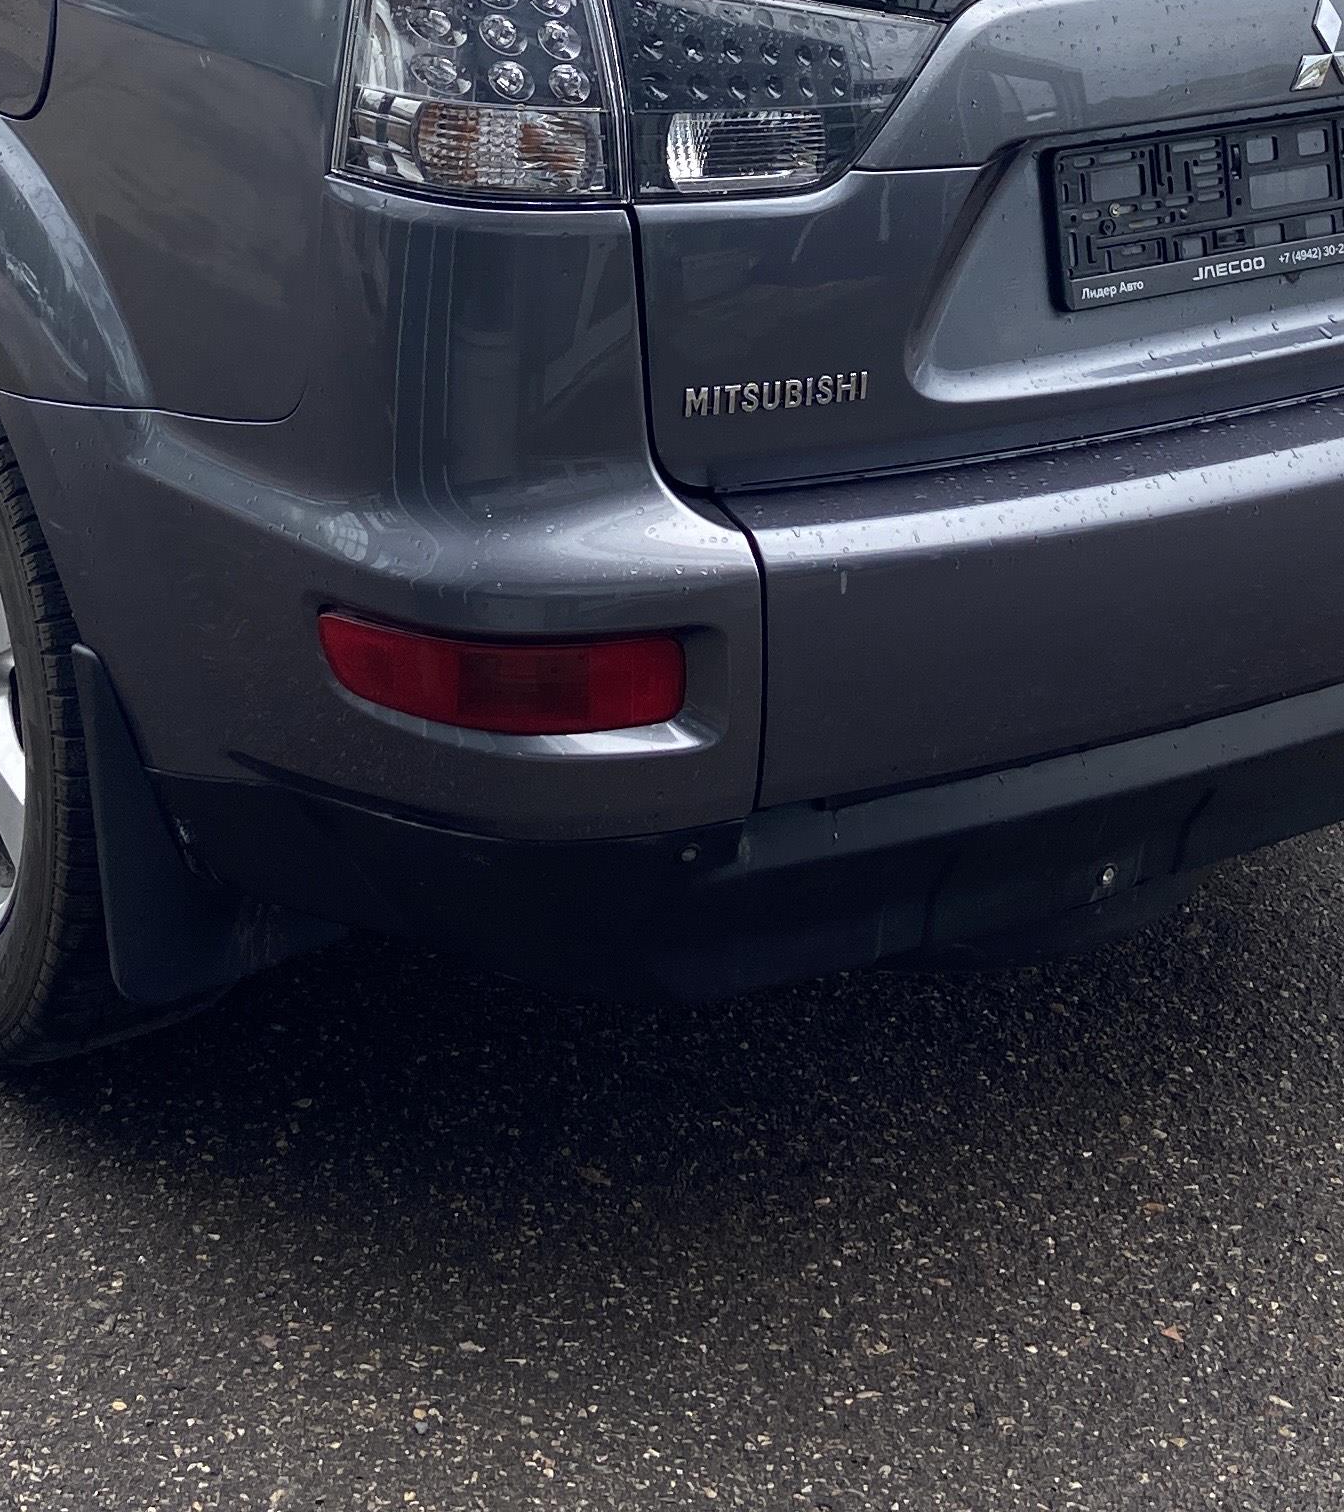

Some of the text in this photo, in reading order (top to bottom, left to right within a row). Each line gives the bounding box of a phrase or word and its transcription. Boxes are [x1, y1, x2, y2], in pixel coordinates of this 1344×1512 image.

[1278, 251, 1293, 265] +7
[1294, 245, 1322, 264] (4942)
[1192, 256, 1265, 281] JAECOO
[1081, 279, 1144, 300] Лидер Авто
[685, 370, 868, 418] MITSUBISHI
